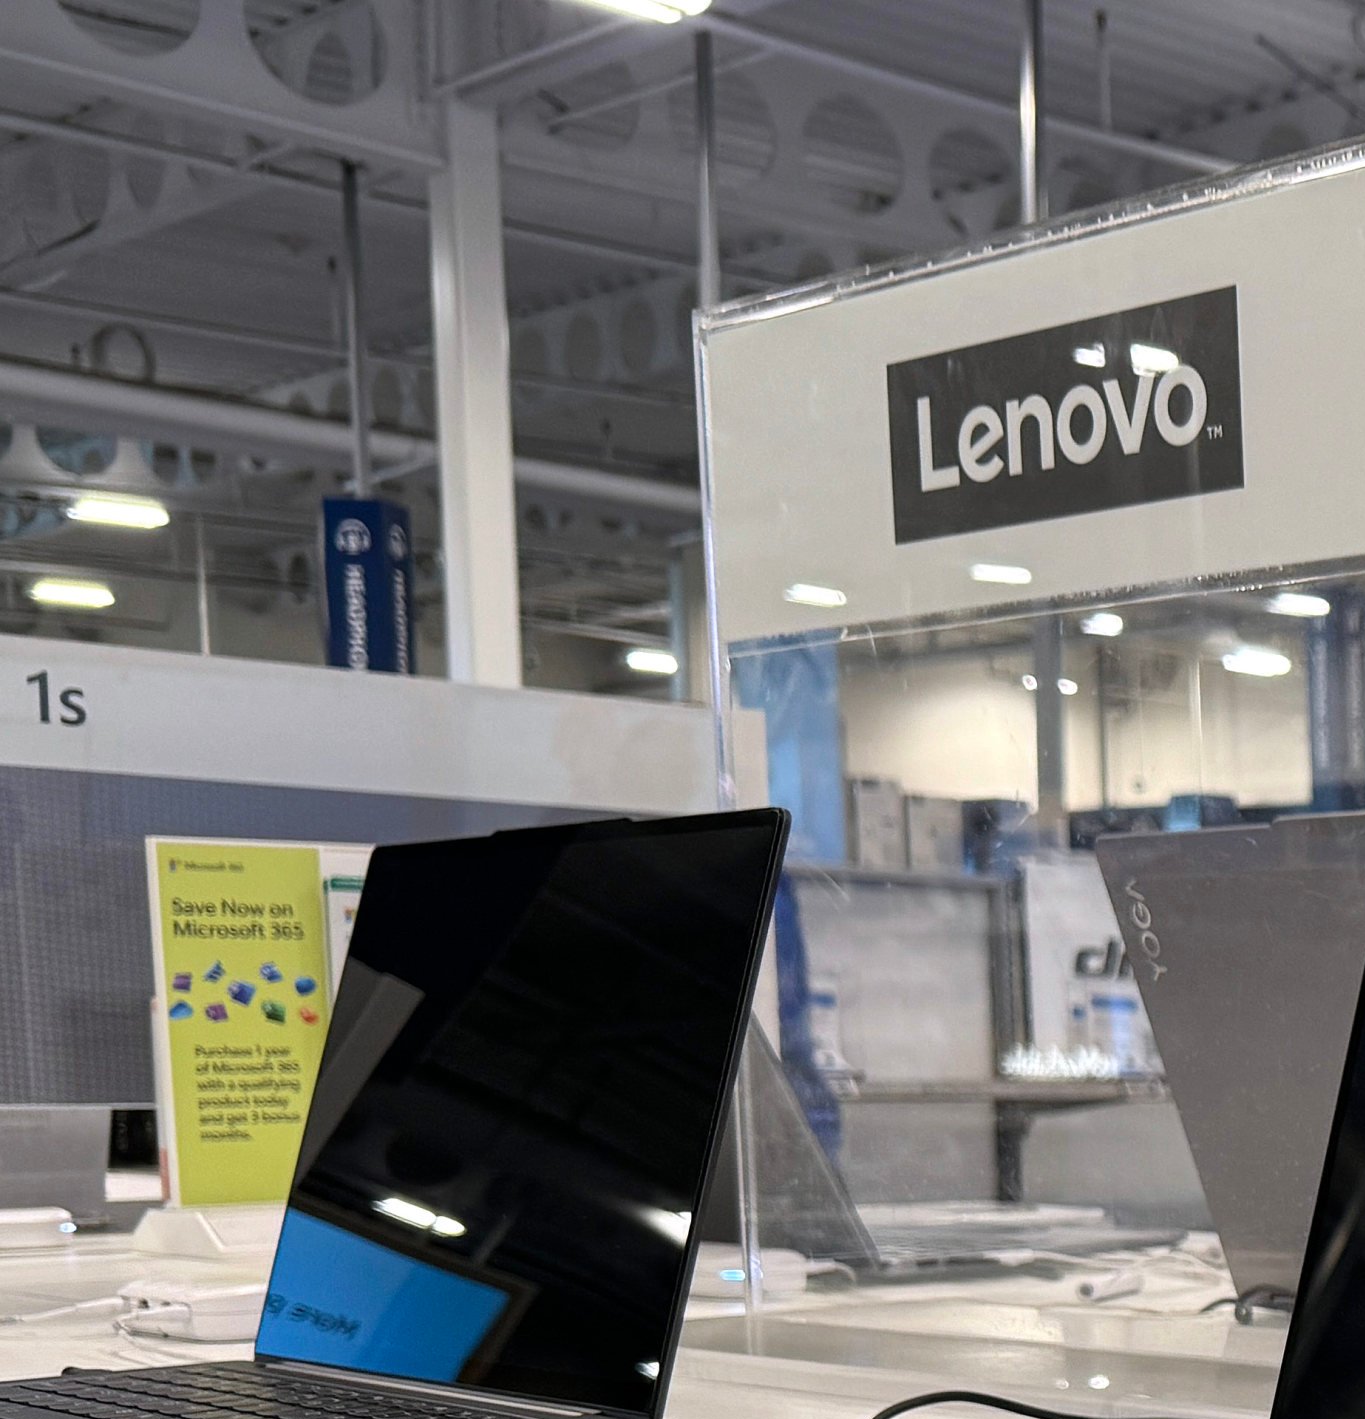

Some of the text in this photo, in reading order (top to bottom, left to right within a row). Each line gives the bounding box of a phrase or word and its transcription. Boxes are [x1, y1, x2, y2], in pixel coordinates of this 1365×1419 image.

[917, 364, 1208, 492] Lenovo
[26, 669, 87, 727] 1s
[172, 897, 294, 918] Save Now on
[173, 919, 305, 941] Microsoft 365
[1125, 878, 1168, 982] YOGA
[195, 1044, 252, 1058] Purchase
[212, 1061, 274, 1074] Microsoft
[198, 1077, 226, 1091] with
[198, 1094, 250, 1110] product
[200, 1110, 224, 1125] and
